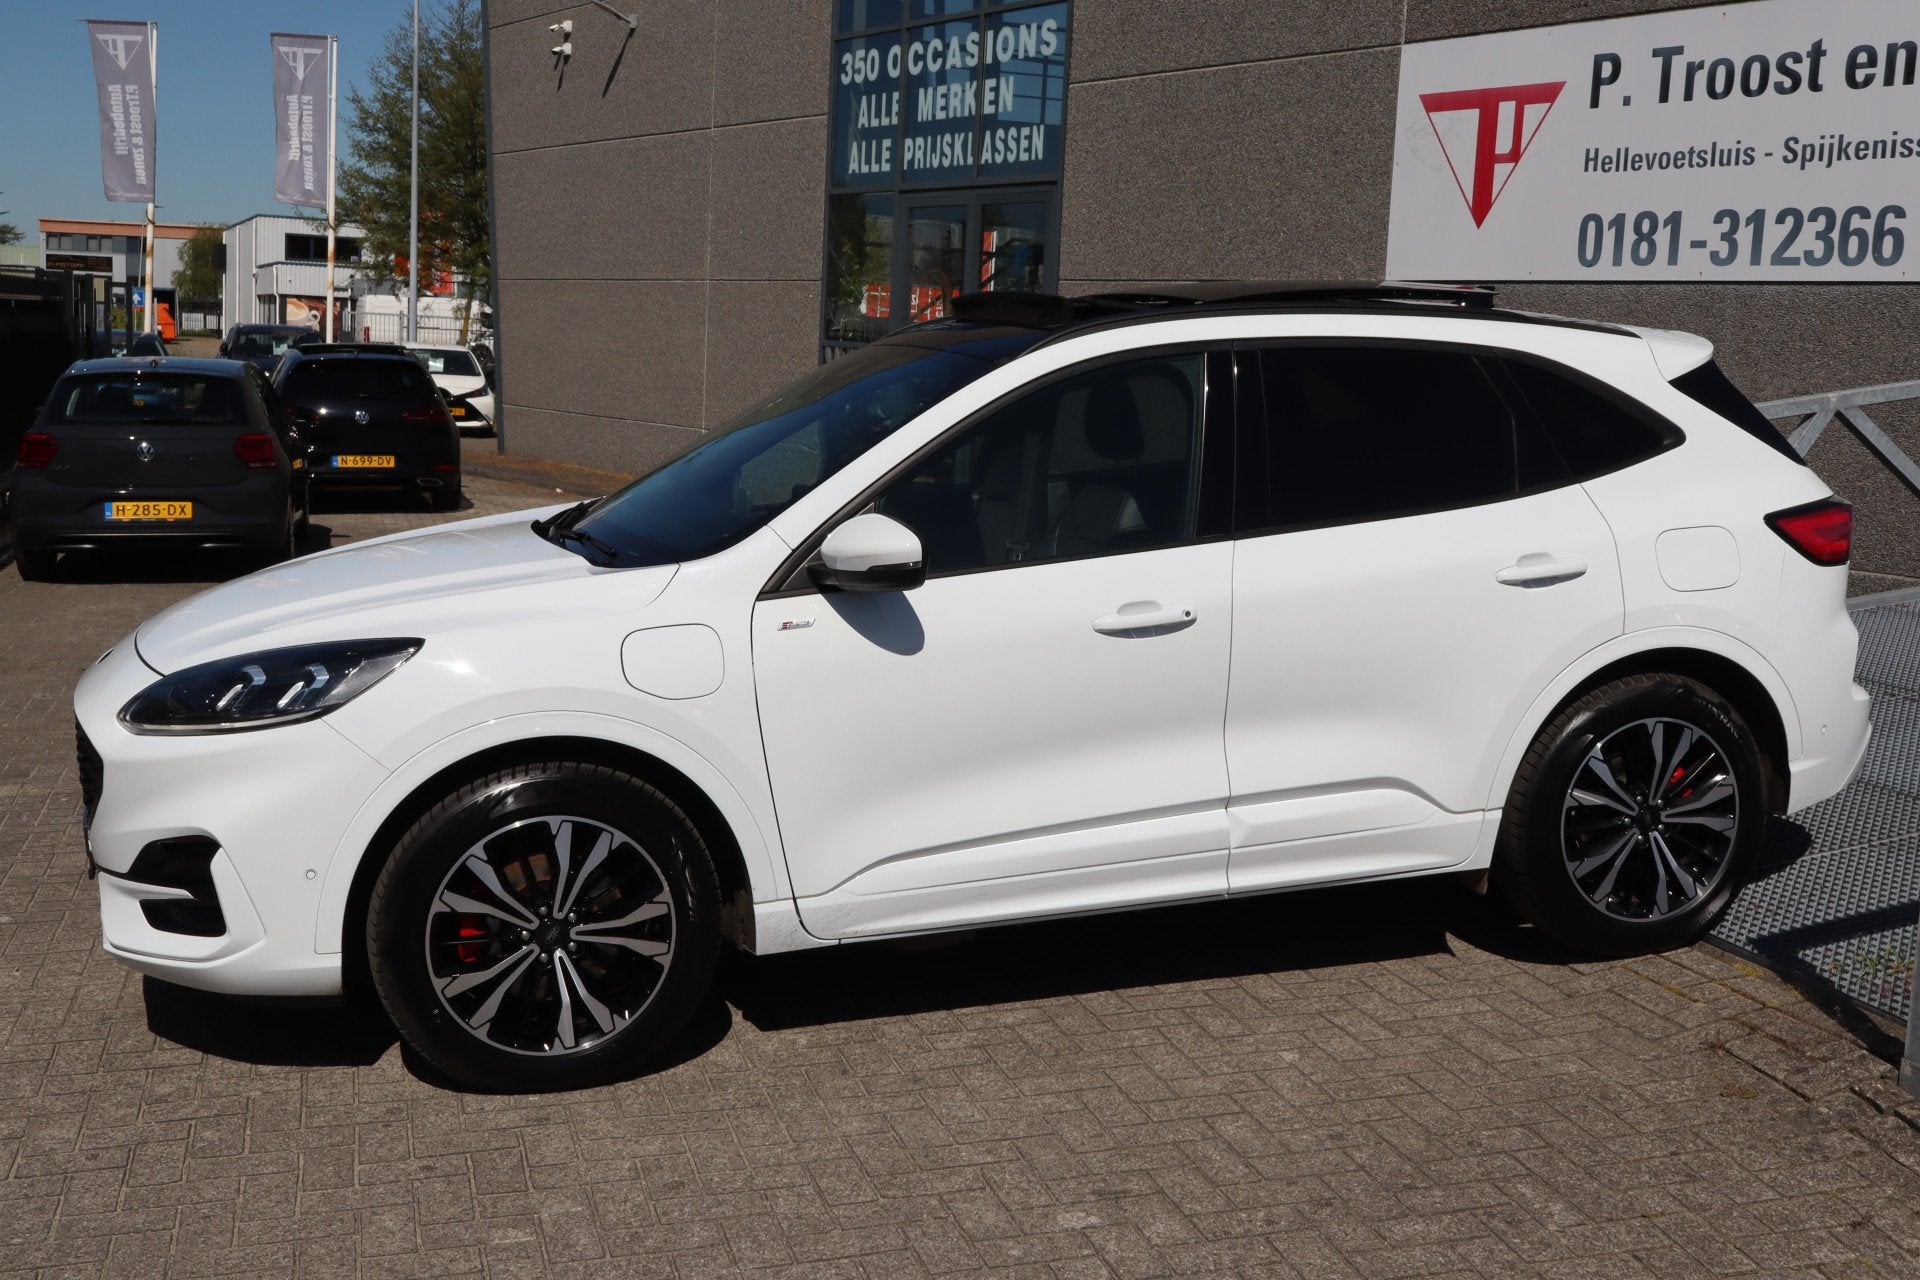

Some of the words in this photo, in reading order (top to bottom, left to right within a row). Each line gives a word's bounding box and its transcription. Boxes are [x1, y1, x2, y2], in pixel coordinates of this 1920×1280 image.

[840, 48, 880, 86] 350
[886, 18, 1058, 79] OCCASIONS
[1589, 52, 1632, 110] P.
[1651, 37, 1828, 104] Troost
[1844, 40, 1918, 90] en
[857, 91, 900, 129] ALLE
[917, 75, 1015, 123] MERKEN
[848, 138, 892, 175] ALLE
[903, 124, 1045, 171] PRIJSKLASSEN
[1583, 140, 1756, 174] Hellevoetsluis
[1576, 204, 1908, 268] 0181-312366
[340, 455, 392, 467] N-699-DV
[115, 503, 187, 517] H-285-DX
